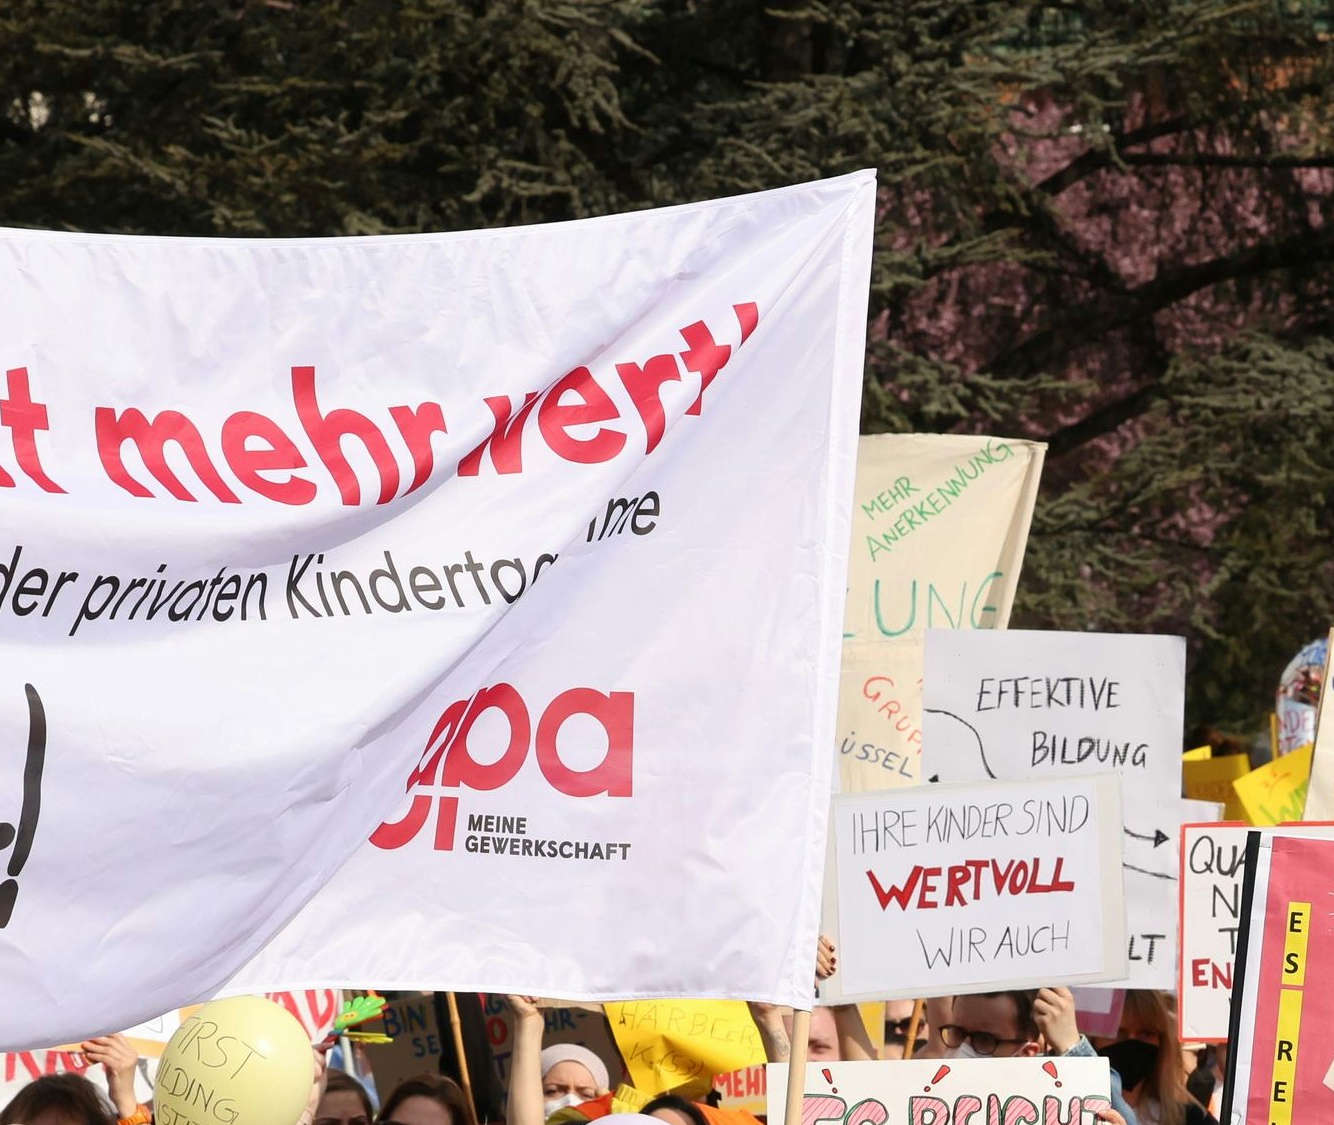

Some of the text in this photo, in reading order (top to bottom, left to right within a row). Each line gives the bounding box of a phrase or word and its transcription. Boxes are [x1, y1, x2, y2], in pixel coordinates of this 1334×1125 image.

[95, 366, 447, 507] mehr
[861, 476, 922, 520] MEHR
[866, 438, 1016, 562] ANERKENNUNG
[68, 563, 267, 637] privaten
[976, 675, 1123, 713] EFFEKTIVE
[1031, 730, 1149, 769] BILDUNG
[465, 835, 632, 860] GEWERKSCHAFT
[467, 814, 527, 835] MEINE
[851, 794, 1091, 855] IHRE KINDER SIND
[865, 856, 1076, 912] WERTVOLL
[915, 919, 1072, 971] WIR AUCH
[1284, 911, 1304, 974] ES
[713, 1067, 767, 1099] MEH
